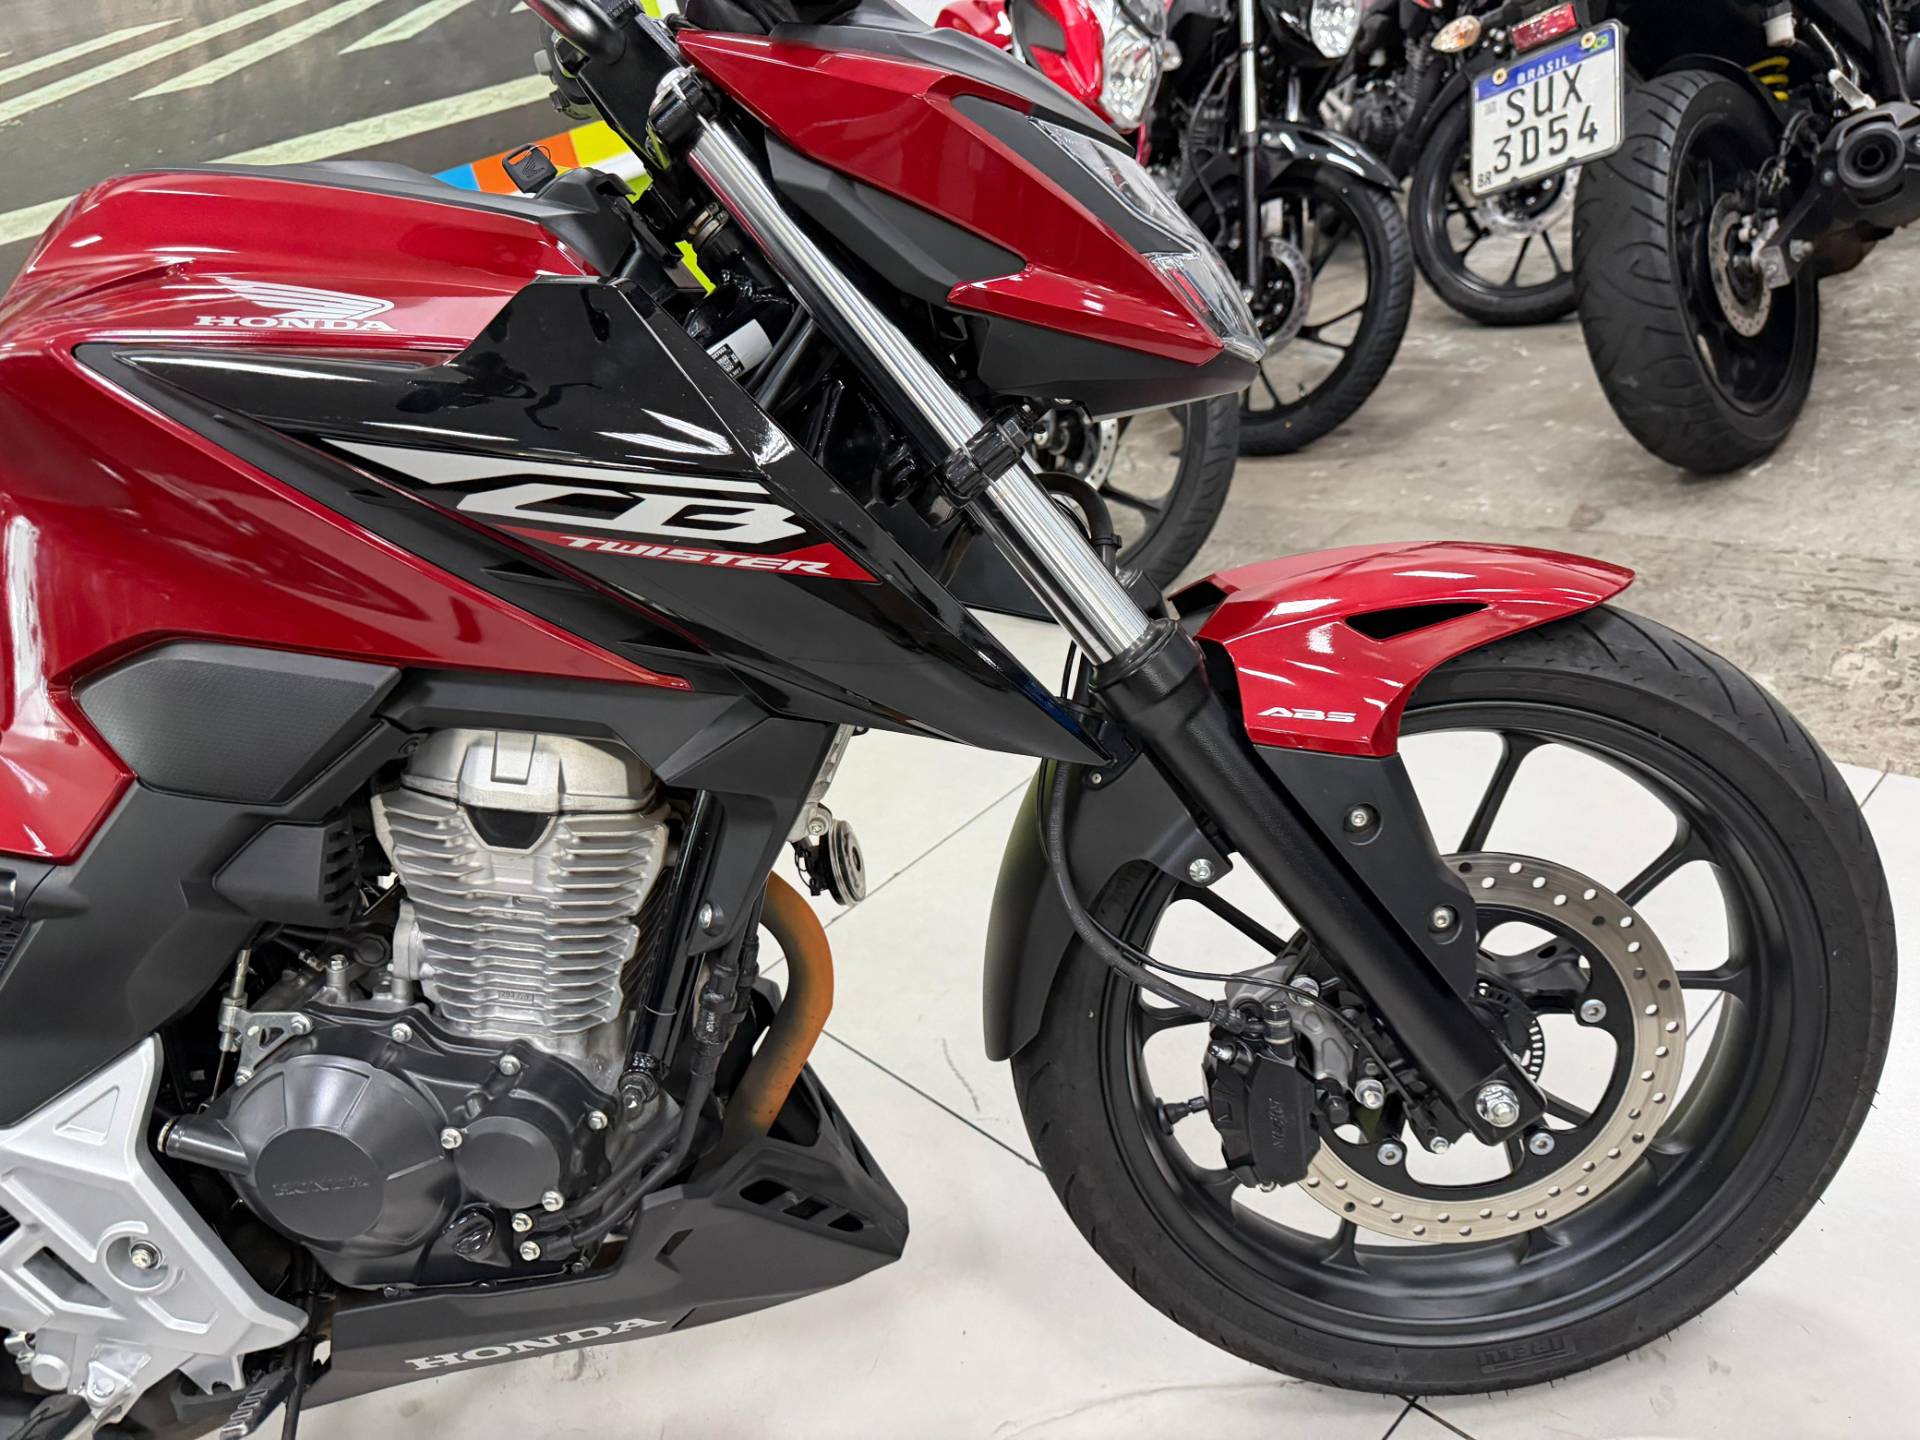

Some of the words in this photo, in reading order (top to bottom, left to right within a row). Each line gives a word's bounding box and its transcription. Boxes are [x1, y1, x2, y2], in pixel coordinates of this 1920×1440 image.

[1517, 56, 1571, 85] BRASIL
[1506, 64, 1583, 128] SUX
[1493, 105, 1599, 174] 3D54
[193, 315, 400, 332] HONDA
[456, 482, 807, 545] CB
[560, 535, 832, 577] TWISTER
[1257, 706, 1357, 723] ABS
[404, 1317, 667, 1372] HONDA
